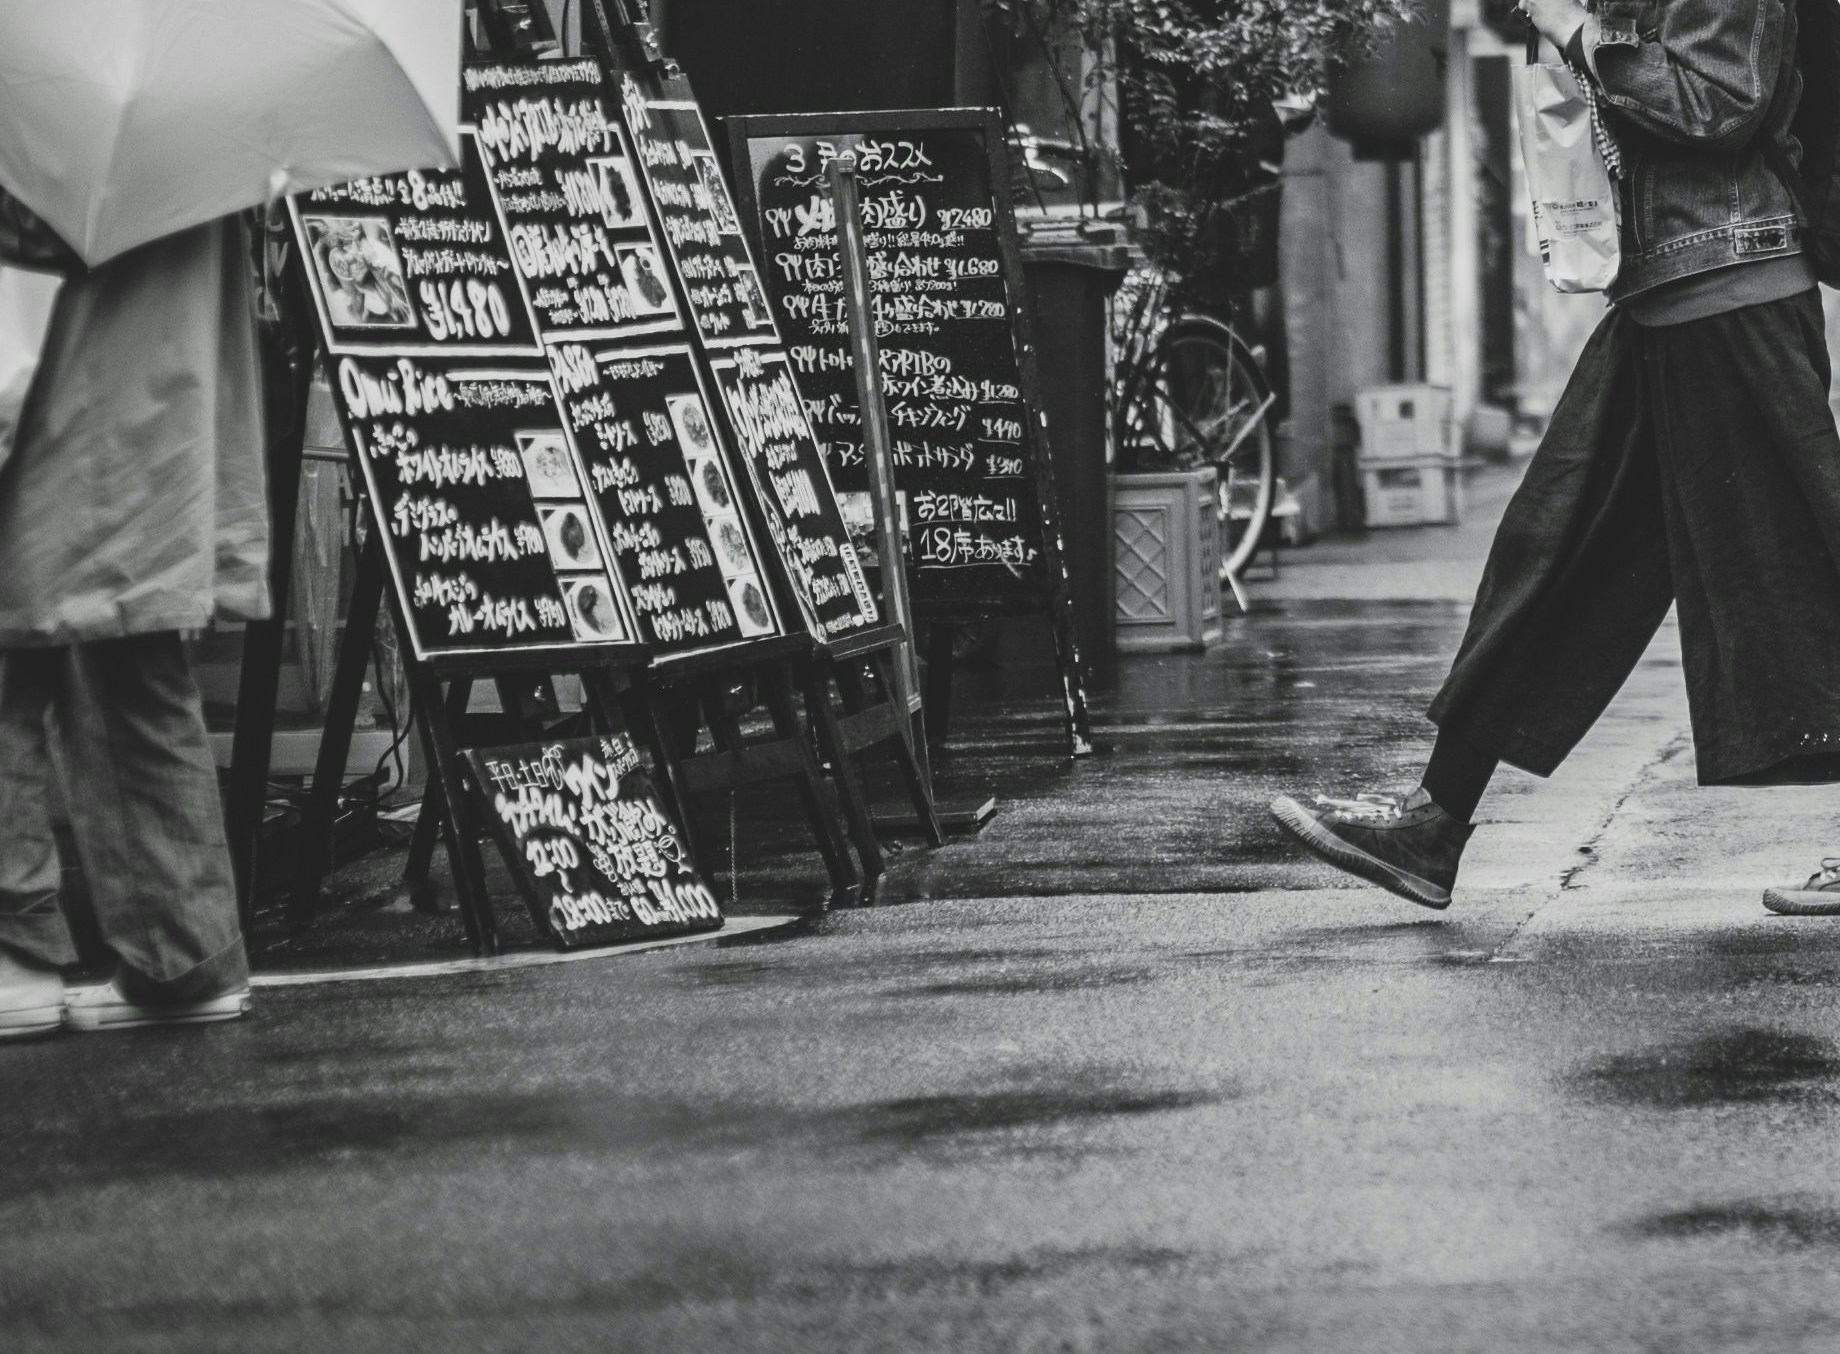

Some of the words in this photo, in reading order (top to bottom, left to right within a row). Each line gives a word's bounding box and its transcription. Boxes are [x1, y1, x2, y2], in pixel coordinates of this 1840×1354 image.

[397, 357, 455, 417] Rice
[564, 751, 620, 810] ワイン
[526, 837, 580, 877] 12:00
[607, 840, 667, 882] 放題
